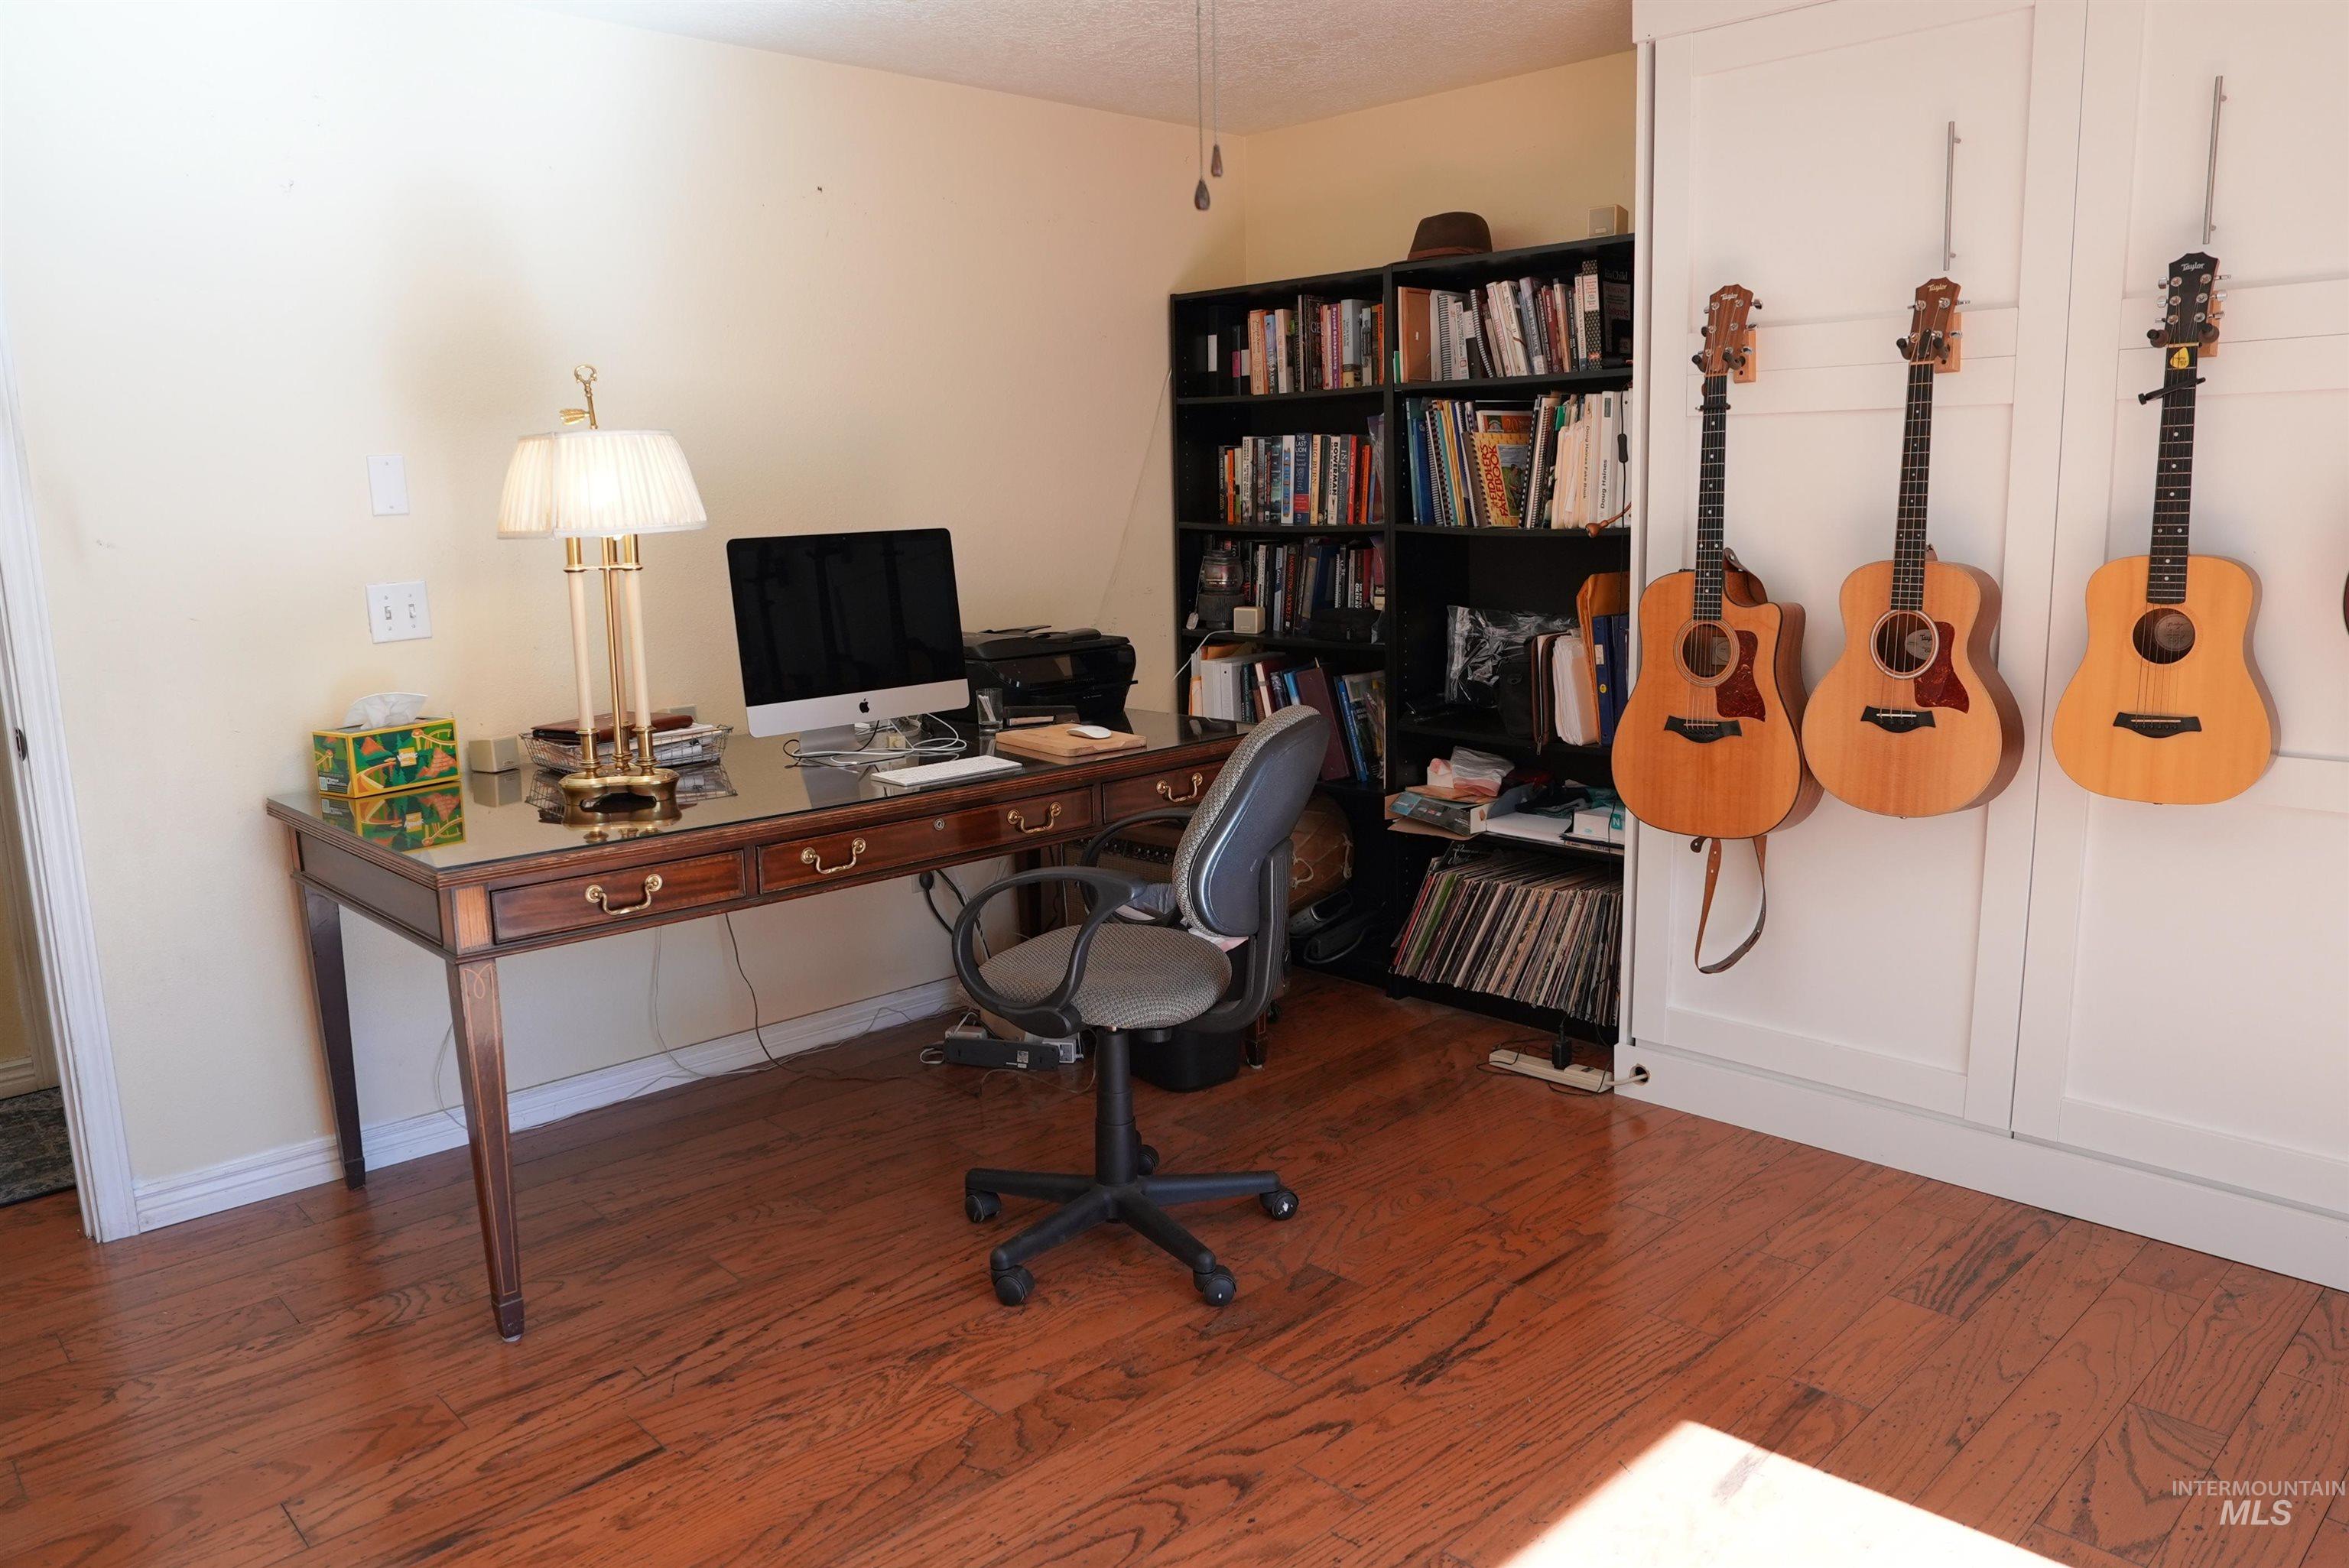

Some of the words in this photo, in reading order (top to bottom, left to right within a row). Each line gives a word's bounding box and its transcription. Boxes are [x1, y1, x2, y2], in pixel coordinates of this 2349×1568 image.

[2180, 261, 2204, 272] Taylor
[1927, 284, 1948, 293] Taylor
[1480, 444, 1497, 500] FIDDLER'S
[1488, 445, 1509, 518] FAKEBOOK
[1287, 555, 1295, 592] MARKETING
[1613, 817, 1620, 826] N
